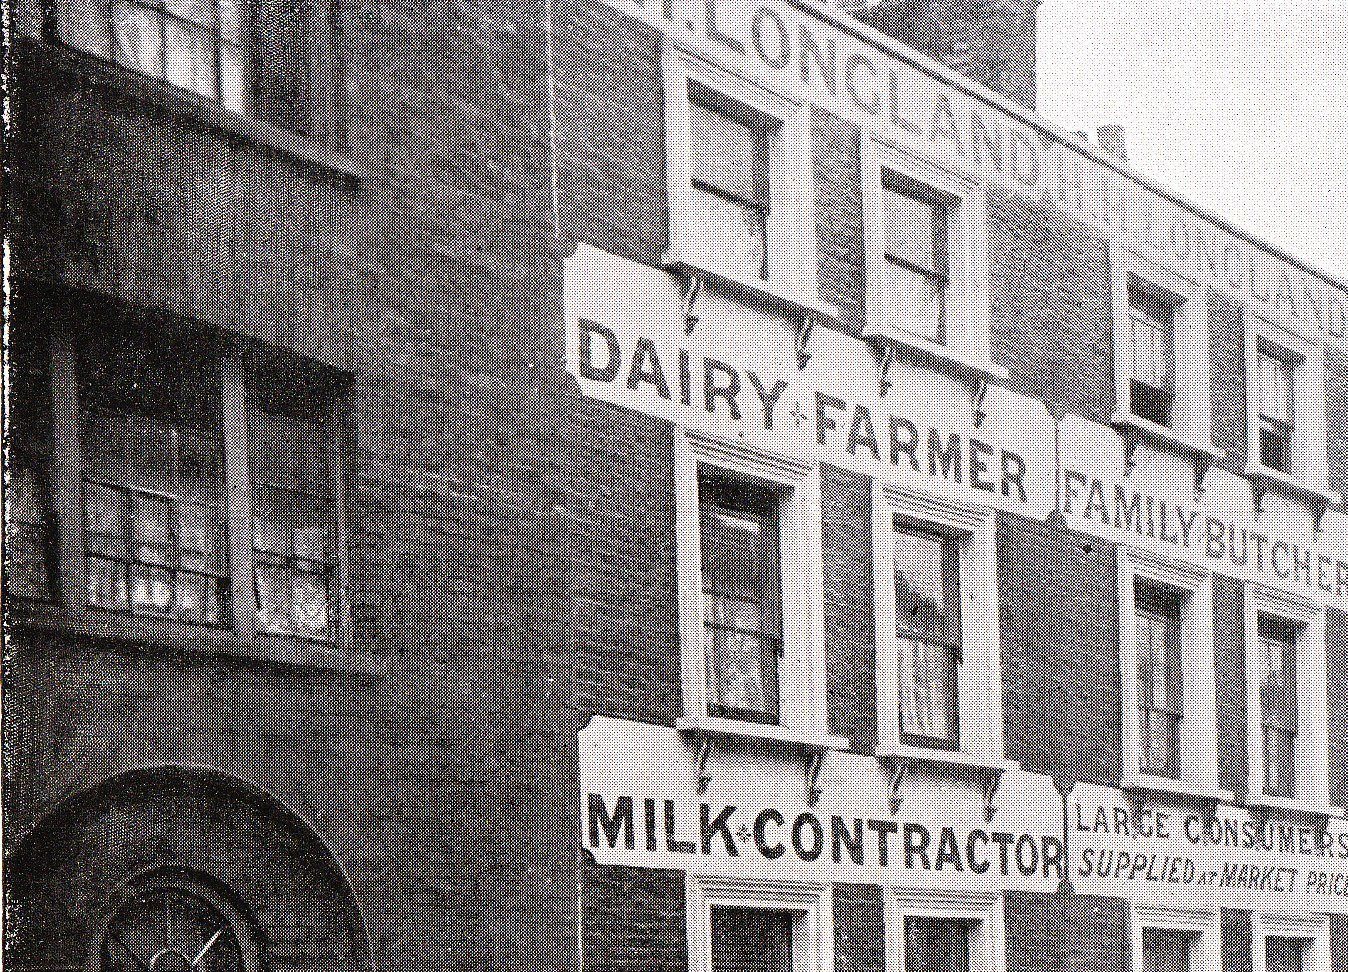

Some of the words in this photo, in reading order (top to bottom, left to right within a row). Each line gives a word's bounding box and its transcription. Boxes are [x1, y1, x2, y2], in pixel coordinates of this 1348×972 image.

[578, 318, 788, 432] DAIRY
[815, 390, 1027, 503] FARMER
[1063, 468, 1203, 548] FAMILY
[588, 794, 740, 856] MILK
[753, 811, 1063, 877] CONTRACTOR
[1074, 803, 1170, 840] LARGE
[1077, 847, 1195, 884] SUPPLIED
[1198, 871, 1218, 886] AT
[1219, 862, 1299, 893] MARKET
